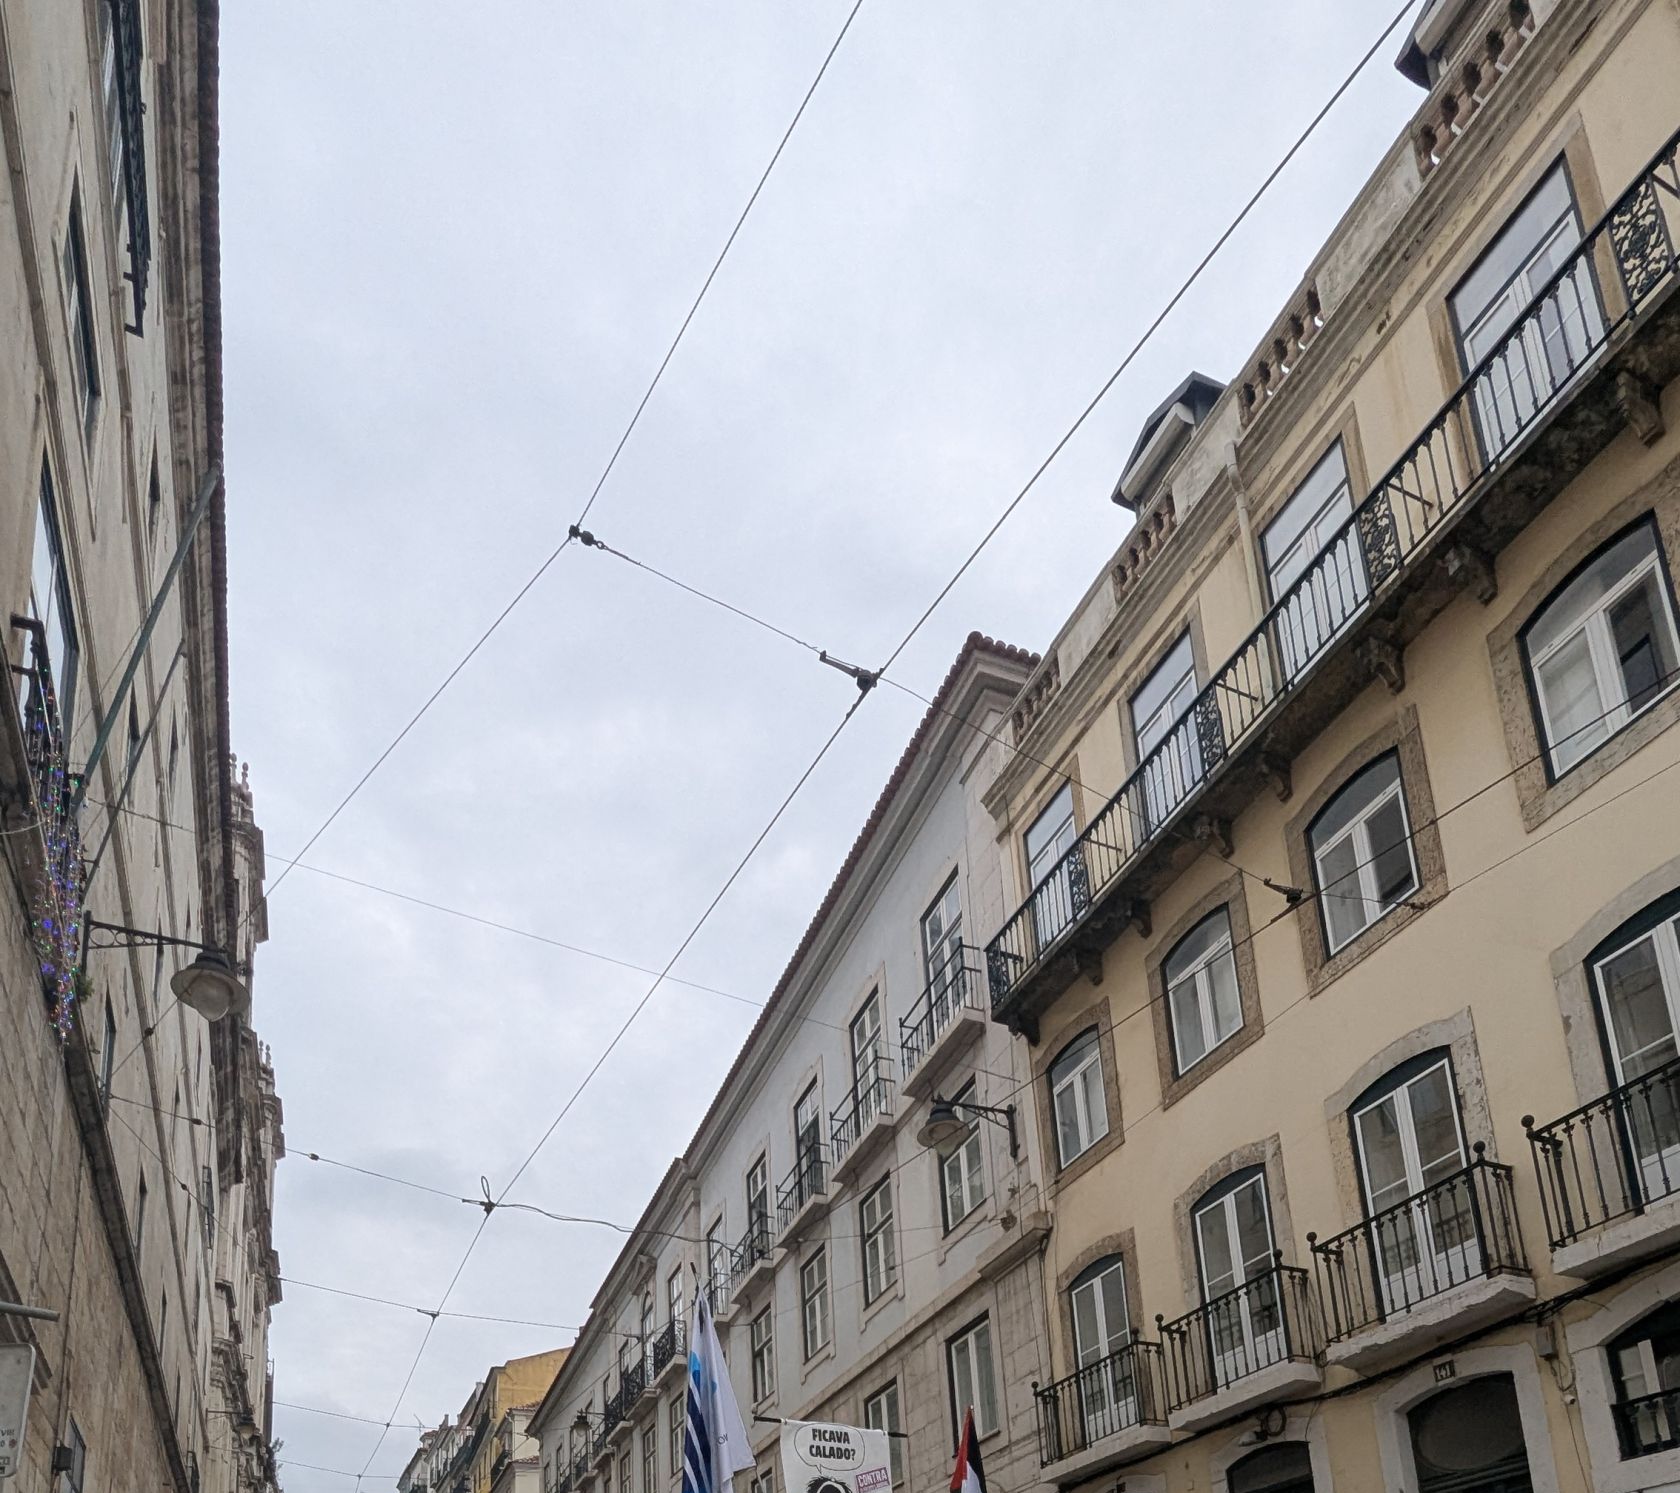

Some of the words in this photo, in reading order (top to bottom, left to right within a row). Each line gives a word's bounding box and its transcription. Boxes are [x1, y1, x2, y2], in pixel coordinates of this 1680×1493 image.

[811, 1428, 851, 1445] FICAVA
[809, 1444, 856, 1461] CALADO?
[857, 1469, 888, 1488] CONTRA
